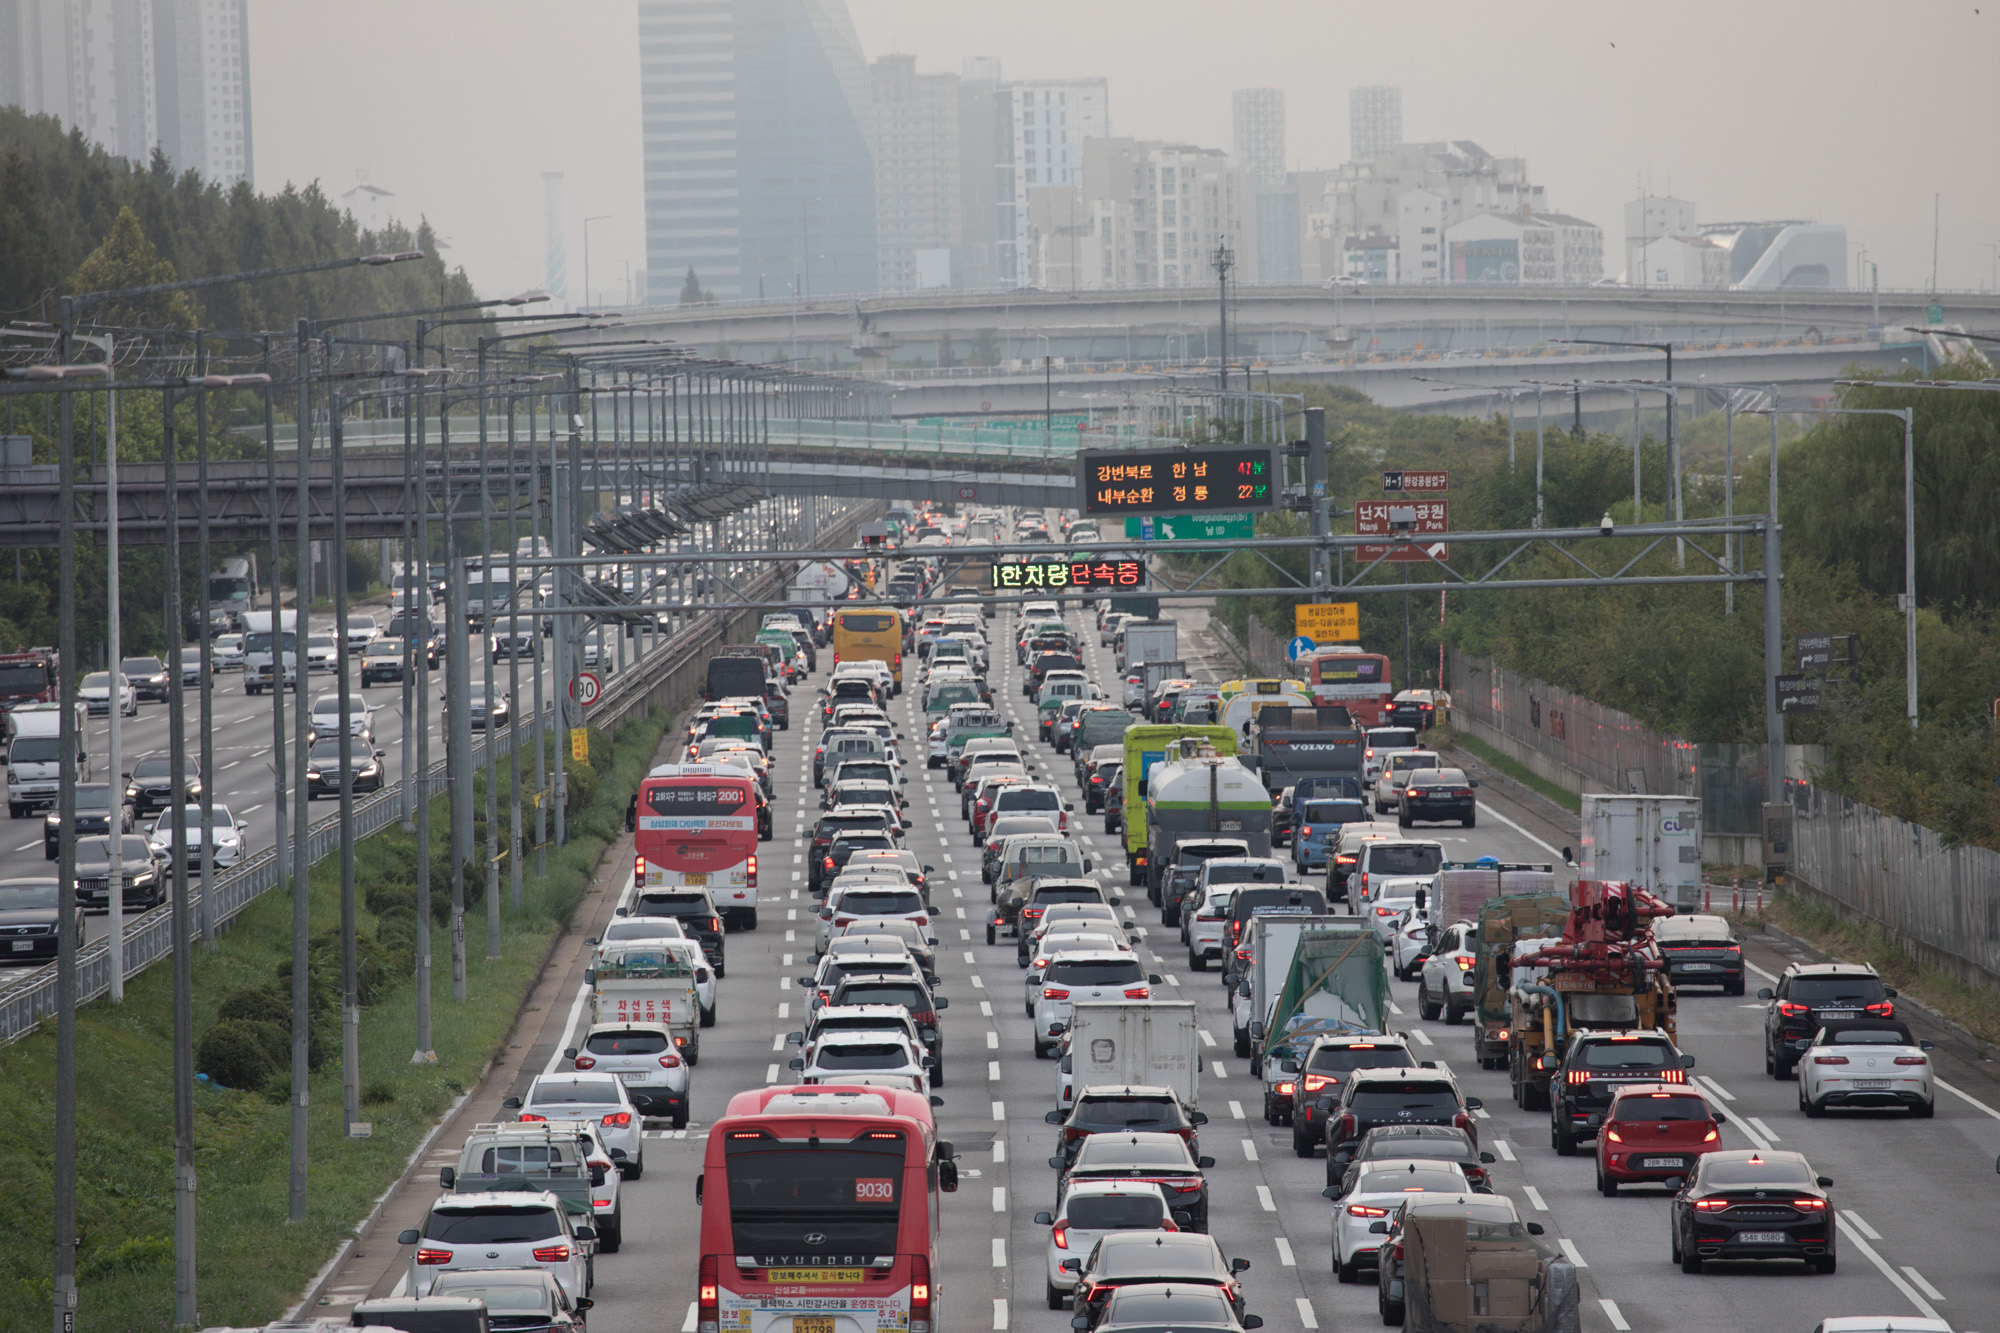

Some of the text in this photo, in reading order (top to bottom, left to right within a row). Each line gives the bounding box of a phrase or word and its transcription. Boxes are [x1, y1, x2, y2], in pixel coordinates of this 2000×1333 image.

[1097, 464, 1153, 481] 강변북로
[1097, 486, 1154, 504] 내부순환
[1360, 504, 1444, 520] 난지공원
[1426, 521, 1443, 530] Park
[718, 791, 739, 801] 200
[650, 820, 678, 829] 삼성화재
[707, 820, 743, 828] 운전자보험
[856, 1182, 893, 1198] 9030
[1761, 1233, 1780, 1241] 0580
[766, 1256, 865, 1265] HYUNDAI
[770, 1271, 861, 1281] 양보해주셔서 감사합니다
[774, 1285, 806, 1295] 신성교통
[760, 1299, 901, 1309] 블랙박스 시민감시단을 운영중입니다
[721, 1310, 738, 1319] 양보
[878, 1309, 896, 1318] 주의
[65, 1314, 73, 1333] E0
